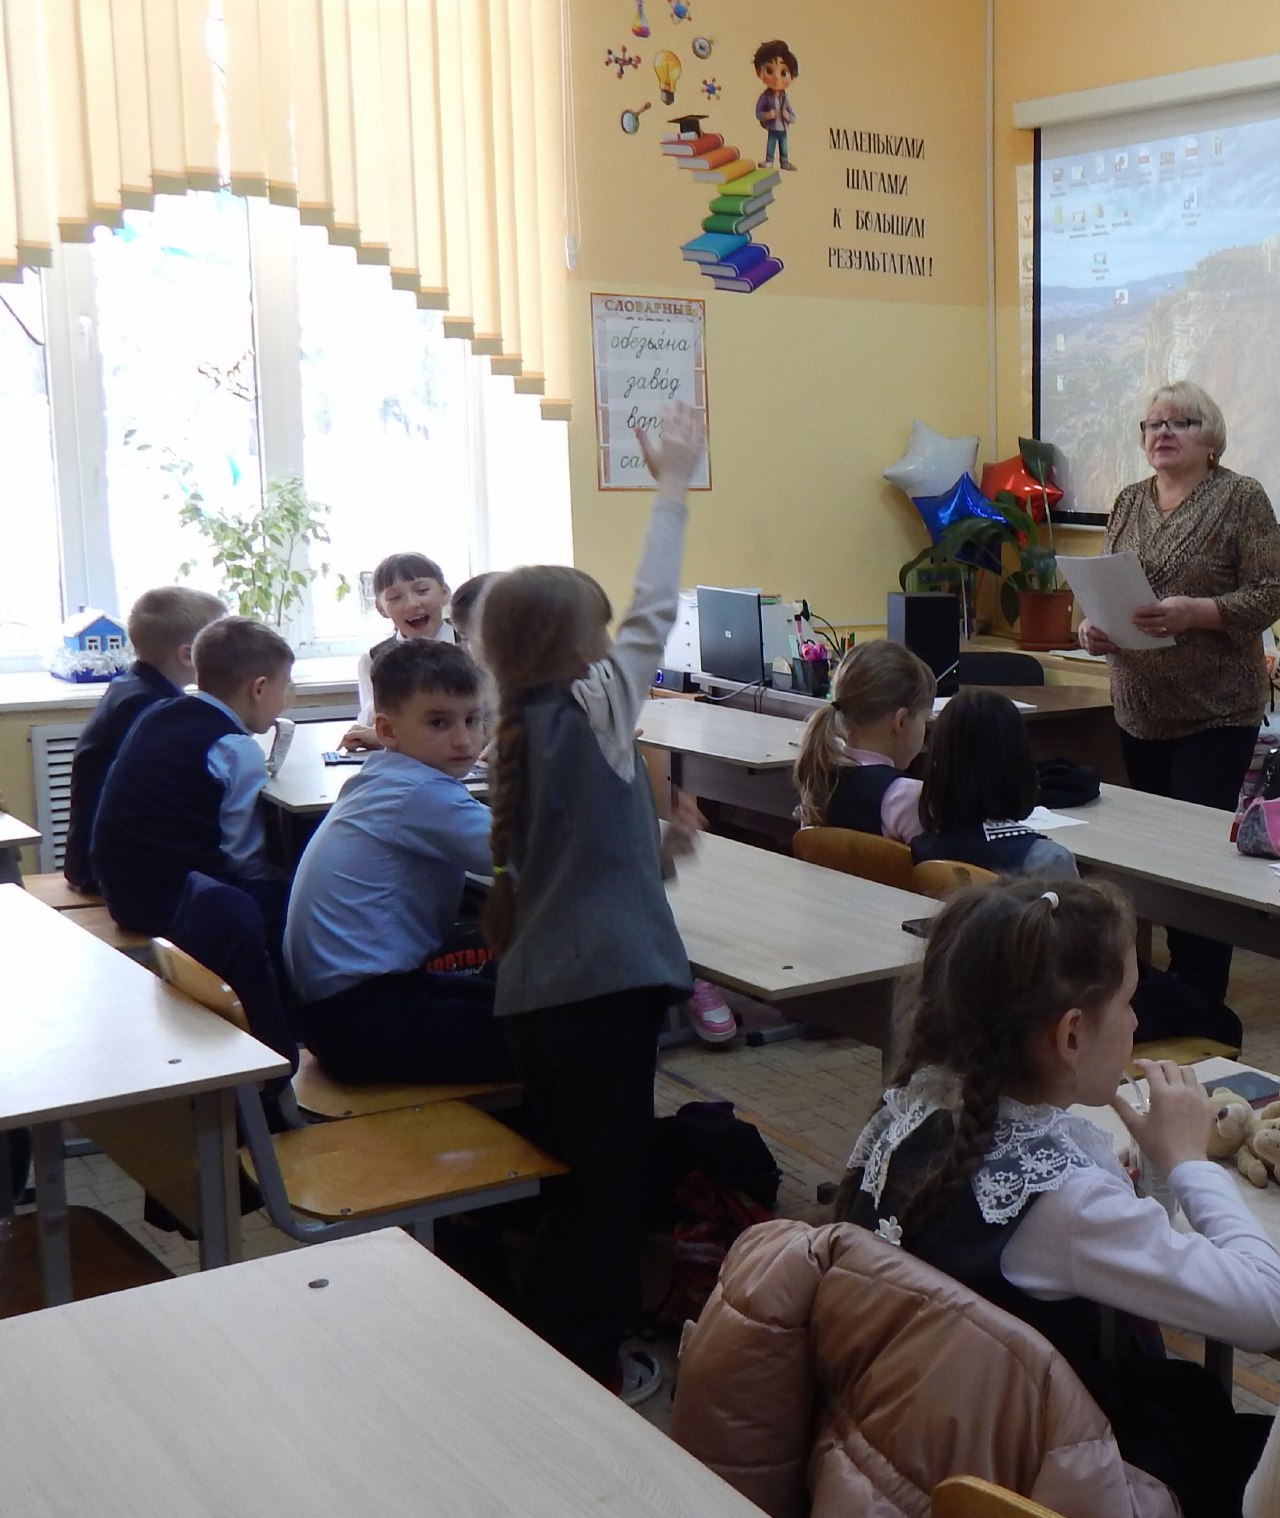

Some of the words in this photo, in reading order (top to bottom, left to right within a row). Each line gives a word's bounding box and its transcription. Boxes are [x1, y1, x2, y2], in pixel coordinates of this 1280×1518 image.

[829, 127, 925, 159] МАЛЕНЬКИМИ
[846, 168, 908, 195] ШАГАМИ
[833, 207, 841, 229] К
[856, 209, 924, 238] БОЛЬШИМ
[828, 246, 932, 277] РЕЗУЛЬТАТАМ!
[604, 299, 692, 315] СЛОВАРНЫЕ
